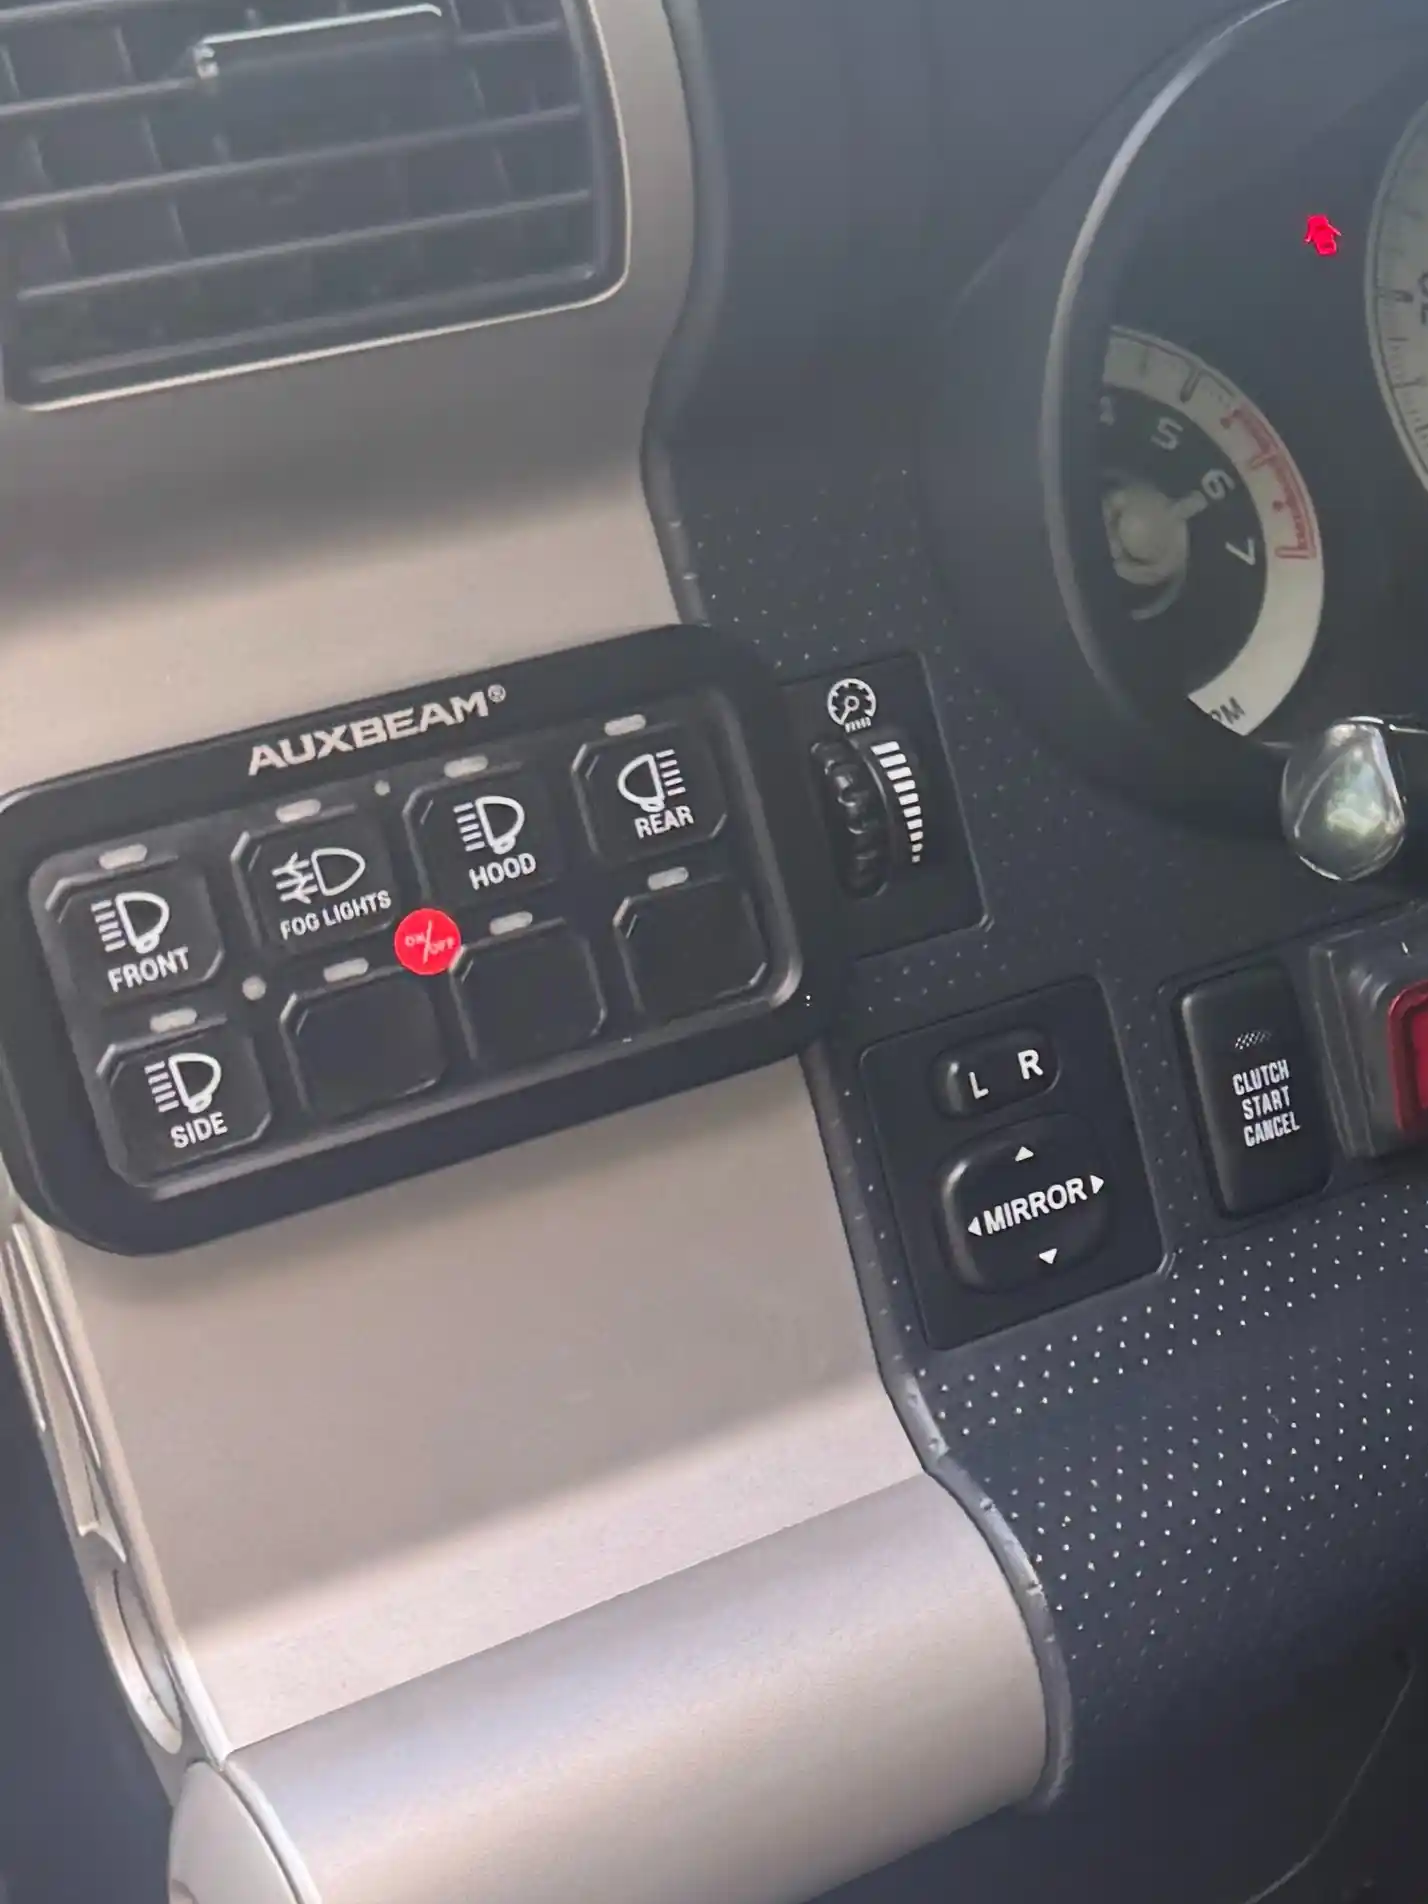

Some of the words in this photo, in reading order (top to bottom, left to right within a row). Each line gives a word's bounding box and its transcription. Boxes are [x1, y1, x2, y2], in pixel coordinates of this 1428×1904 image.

[1152, 417, 1184, 450] 5
[1202, 468, 1236, 500] 6
[1225, 536, 1256, 566] 7
[634, 805, 694, 839] REAR
[469, 853, 537, 890] HOOD
[280, 912, 320, 940] FOG
[322, 890, 392, 927] LIGHTS
[107, 946, 189, 993] FRONT
[969, 1072, 989, 1099] L
[1017, 1049, 1044, 1080] R
[1232, 1058, 1290, 1096] CLUTCH
[1241, 1085, 1291, 1121] START
[170, 1111, 228, 1148] SIDE
[1243, 1111, 1301, 1147] CANCEL
[983, 1177, 1088, 1235] MIRROR
